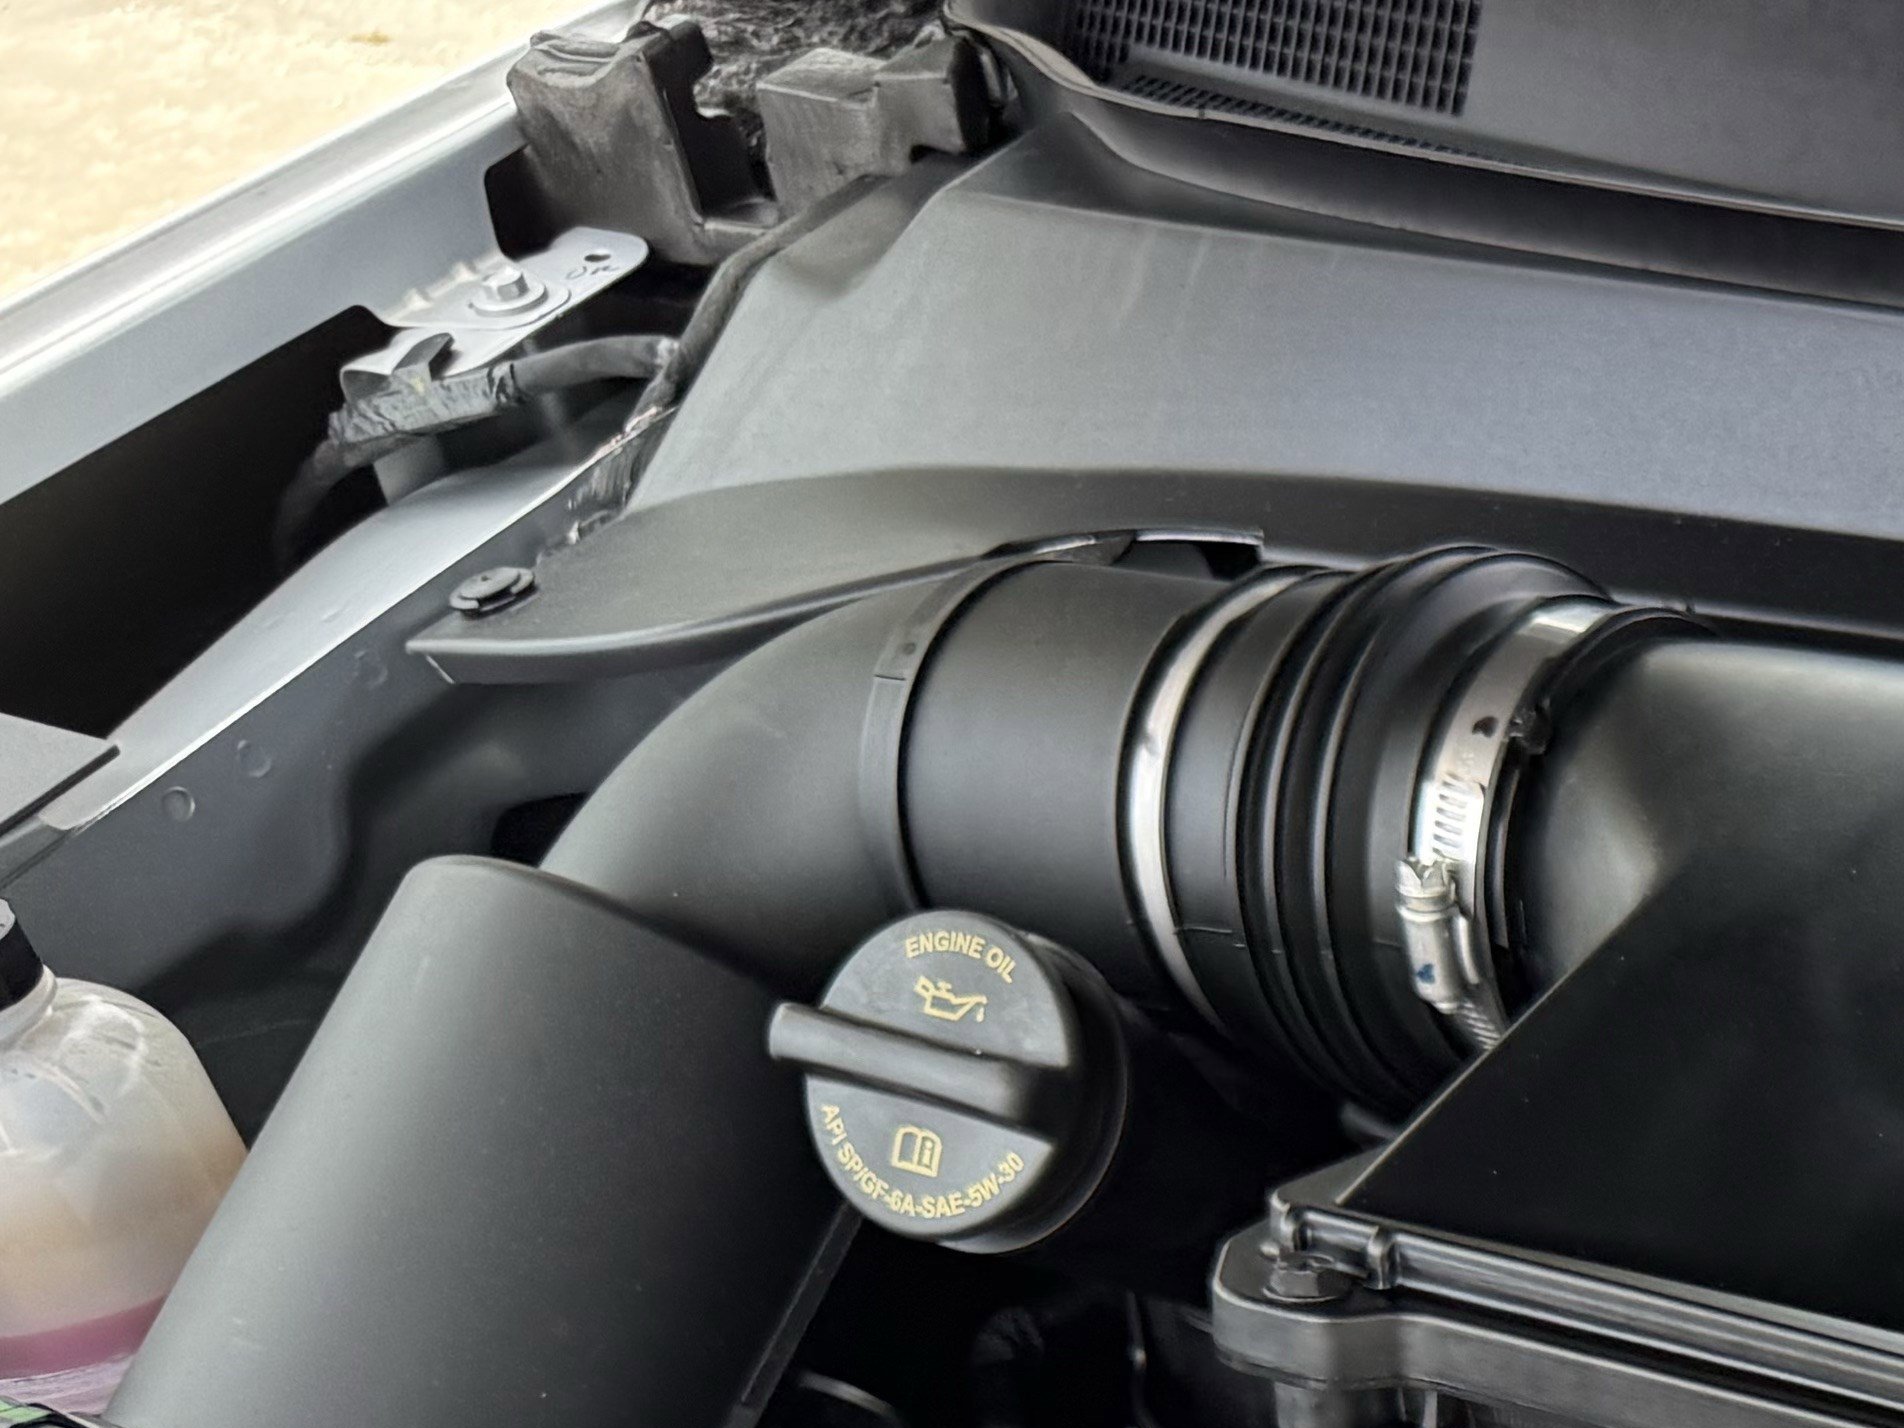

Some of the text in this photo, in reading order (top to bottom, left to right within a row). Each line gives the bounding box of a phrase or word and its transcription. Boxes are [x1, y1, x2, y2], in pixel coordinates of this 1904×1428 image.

[905, 930, 1016, 984] ENGINE OIL
[821, 1103, 848, 1146] API
